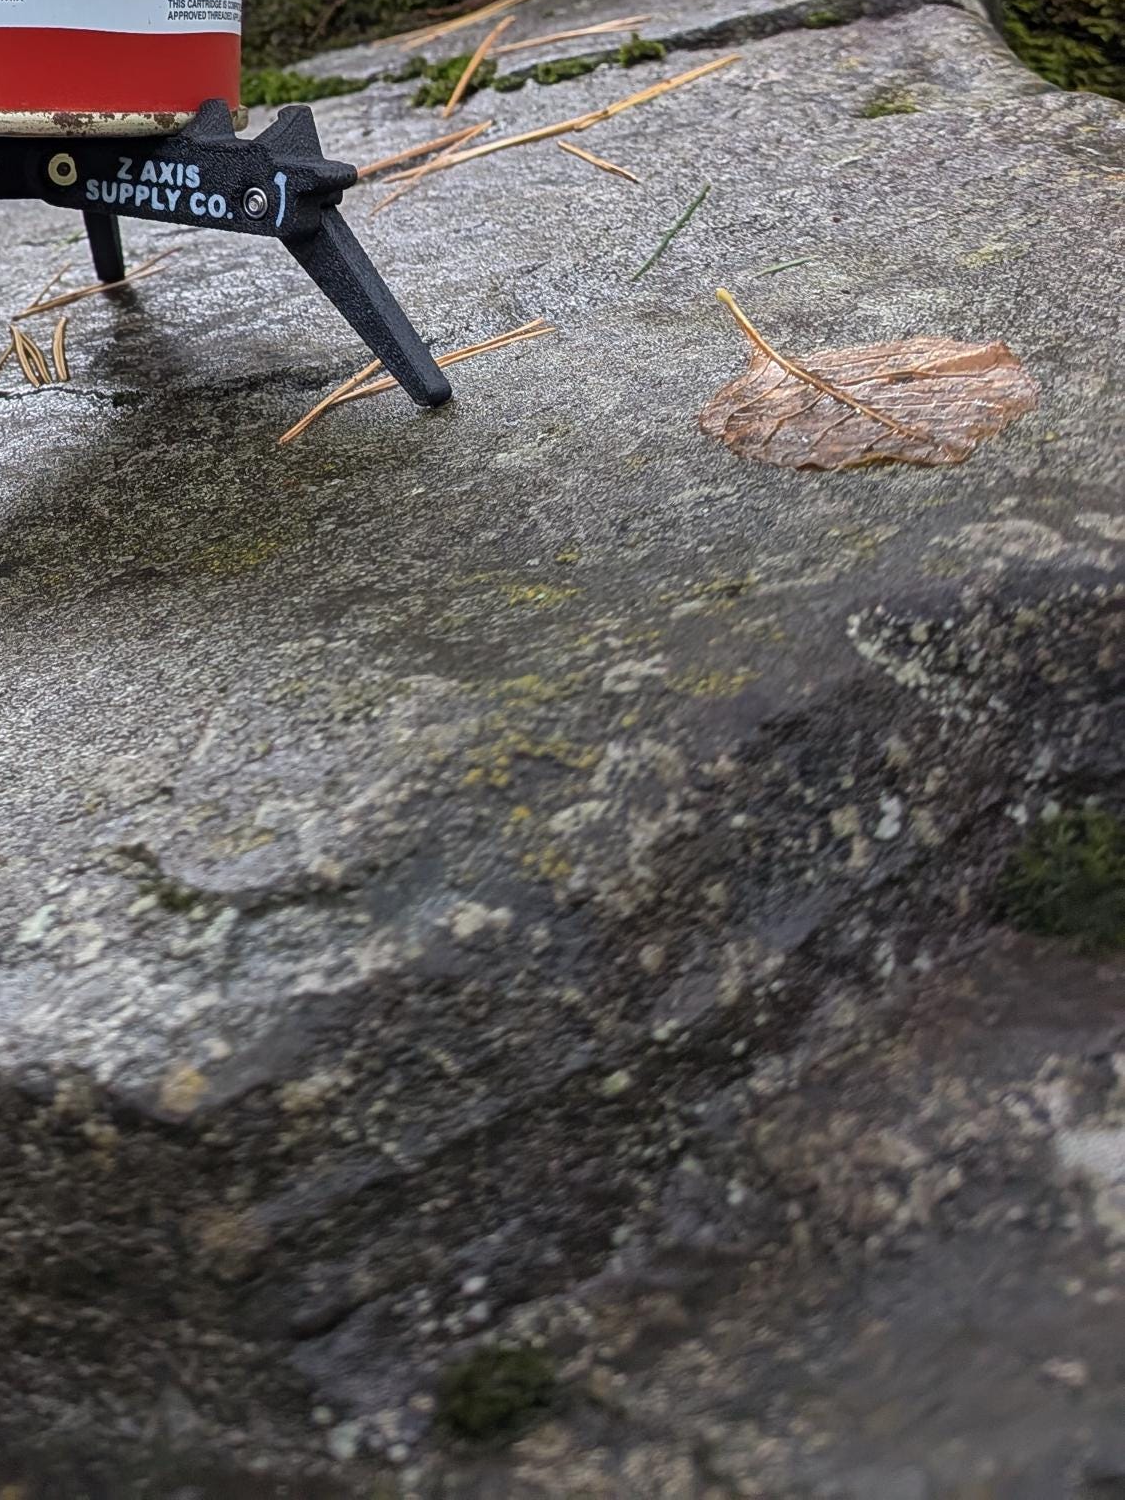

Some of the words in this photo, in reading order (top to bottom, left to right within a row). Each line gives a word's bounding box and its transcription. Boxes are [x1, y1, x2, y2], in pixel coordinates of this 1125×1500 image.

[168, 0, 185, 8] THIS
[187, 0, 222, 8] CARTRIDGE
[167, 11, 206, 20] APPROVED
[117, 156, 133, 180] Z
[140, 160, 201, 188] AXIS
[85, 179, 181, 212] SUPPLY
[189, 192, 234, 220] CO.
